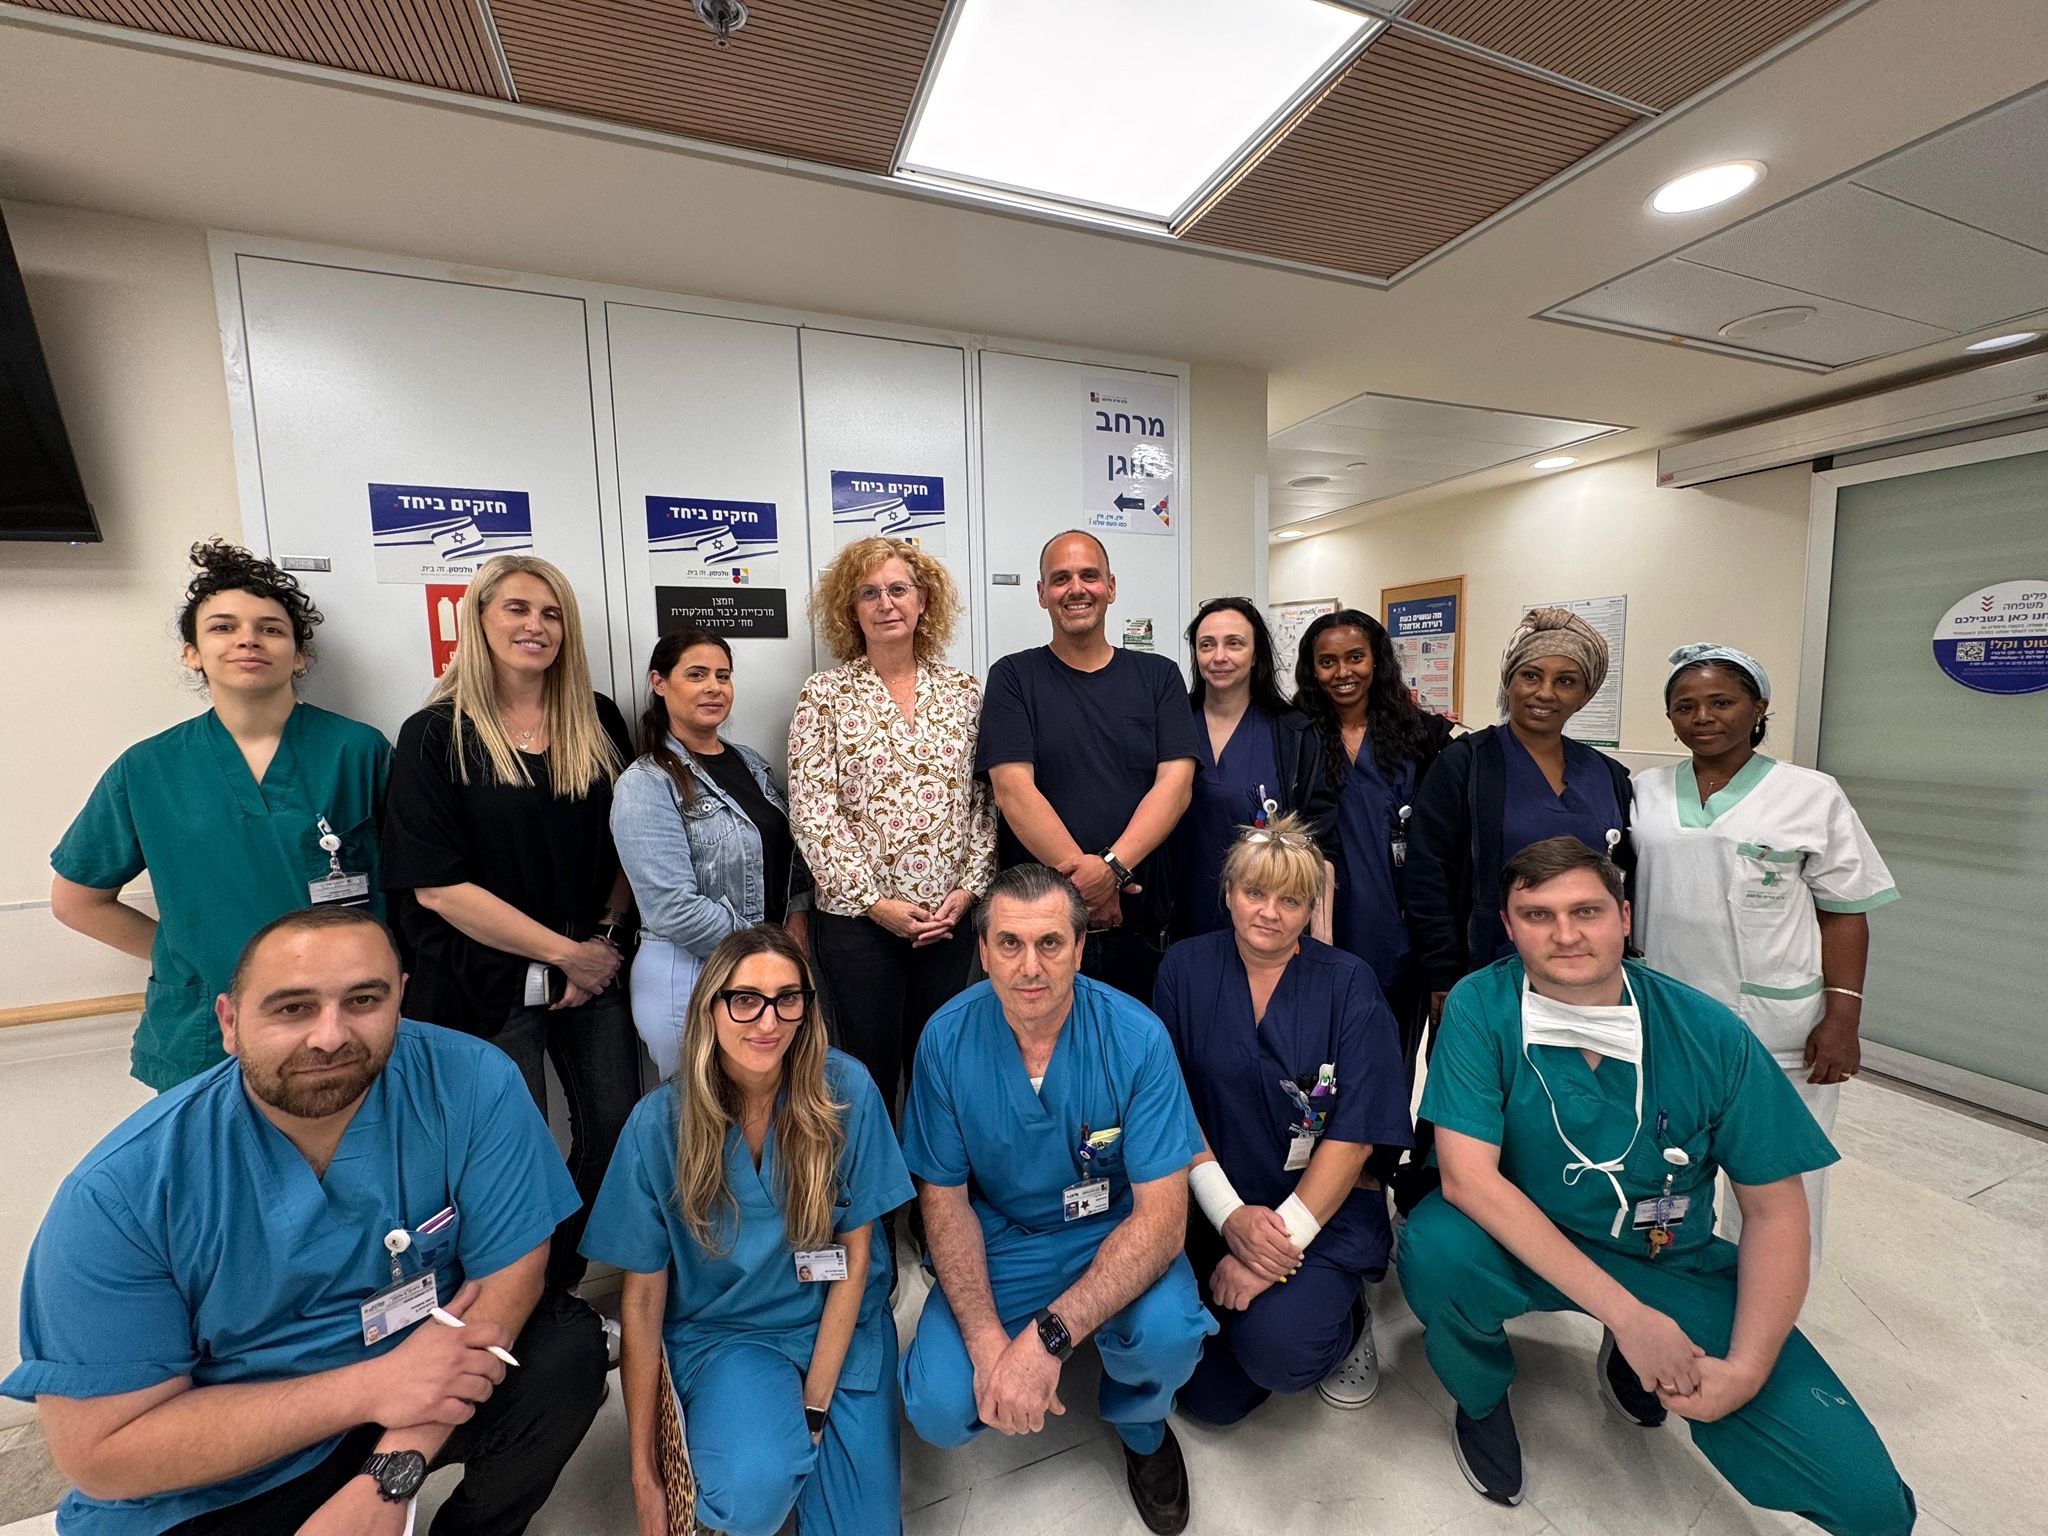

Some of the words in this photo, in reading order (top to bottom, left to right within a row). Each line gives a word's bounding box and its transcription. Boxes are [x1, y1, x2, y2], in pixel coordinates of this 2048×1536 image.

[1096, 410, 1164, 437] מרחב
[888, 482, 929, 497] חזקים
[451, 498, 507, 516] חזקים
[712, 508, 759, 525] חזקים
[712, 597, 734, 606] חמצן
[2022, 593, 2048, 601] פלים
[2003, 602, 2044, 610] משפחה
[671, 607, 714, 617] מחלקתית
[717, 608, 738, 616] גיבוי
[741, 608, 775, 617] מרכזיית
[695, 619, 735, 627] כירורגיה
[1955, 615, 2004, 624] בשבילכם
[2008, 614, 2028, 623] כאן
[1399, 622, 1421, 631] אדמה?
[1422, 620, 1442, 628] רעידת
[1990, 640, 2018, 650] וקל!
